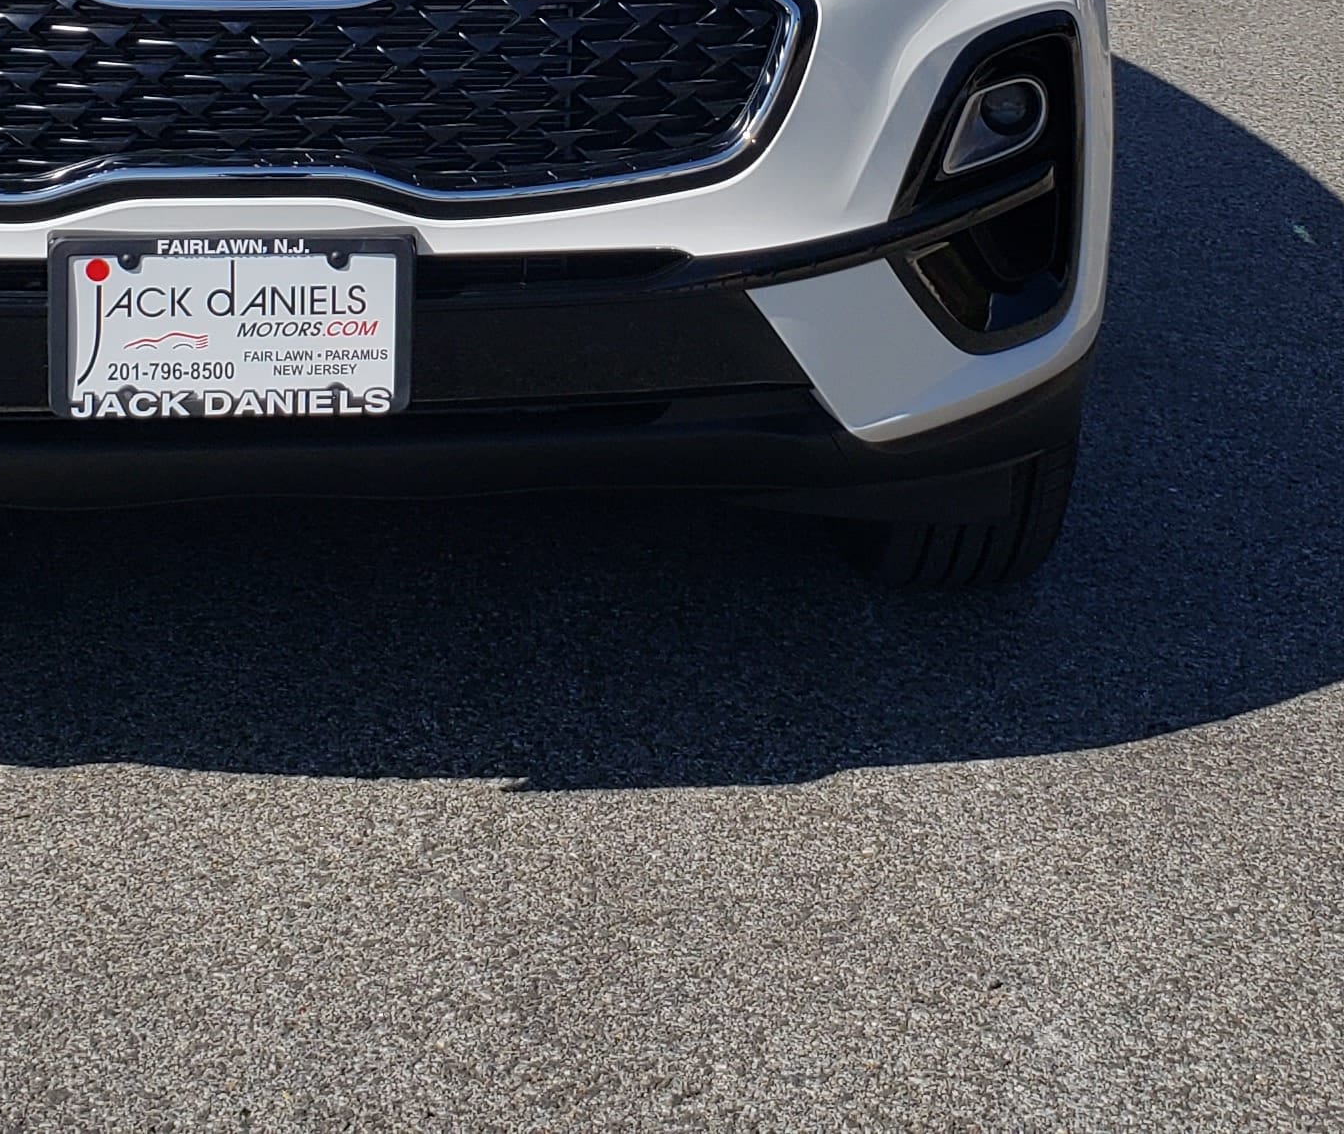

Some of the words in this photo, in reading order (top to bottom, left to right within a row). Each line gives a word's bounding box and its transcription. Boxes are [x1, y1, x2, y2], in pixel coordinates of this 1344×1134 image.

[157, 239, 267, 254] FAIRLAWN,
[274, 238, 310, 254] N.J.
[236, 320, 379, 337] MOTORS.COM
[325, 349, 388, 361] PARAMUS
[107, 361, 234, 381] 201-796-8500
[273, 365, 304, 376] NEW
[306, 364, 357, 376] JERSEY
[70, 391, 191, 418] JACK
[204, 388, 391, 416] DANIELS
